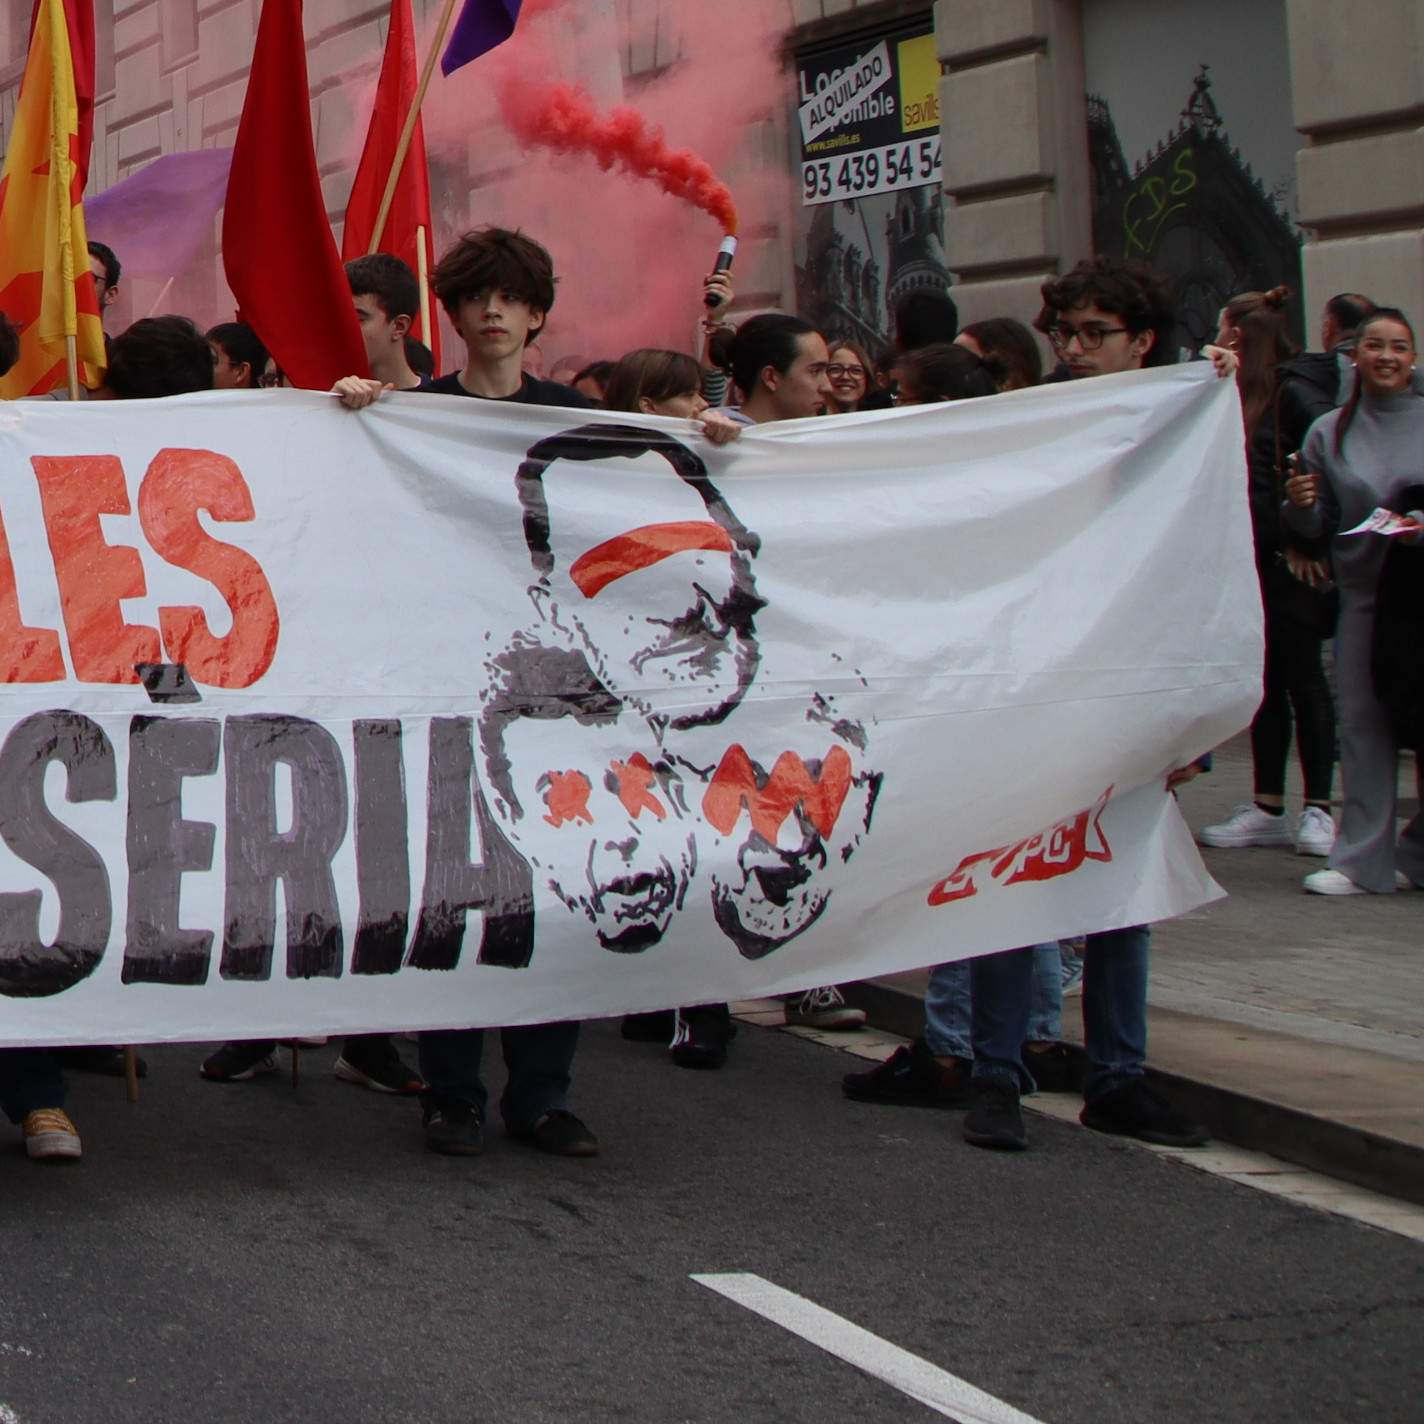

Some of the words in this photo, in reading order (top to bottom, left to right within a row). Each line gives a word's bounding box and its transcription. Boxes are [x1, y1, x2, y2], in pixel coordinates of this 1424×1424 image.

[809, 55, 883, 130] ALQUILADO
[803, 162, 832, 199] 93
[836, 152, 880, 193] 439
[885, 144, 914, 185] 54
